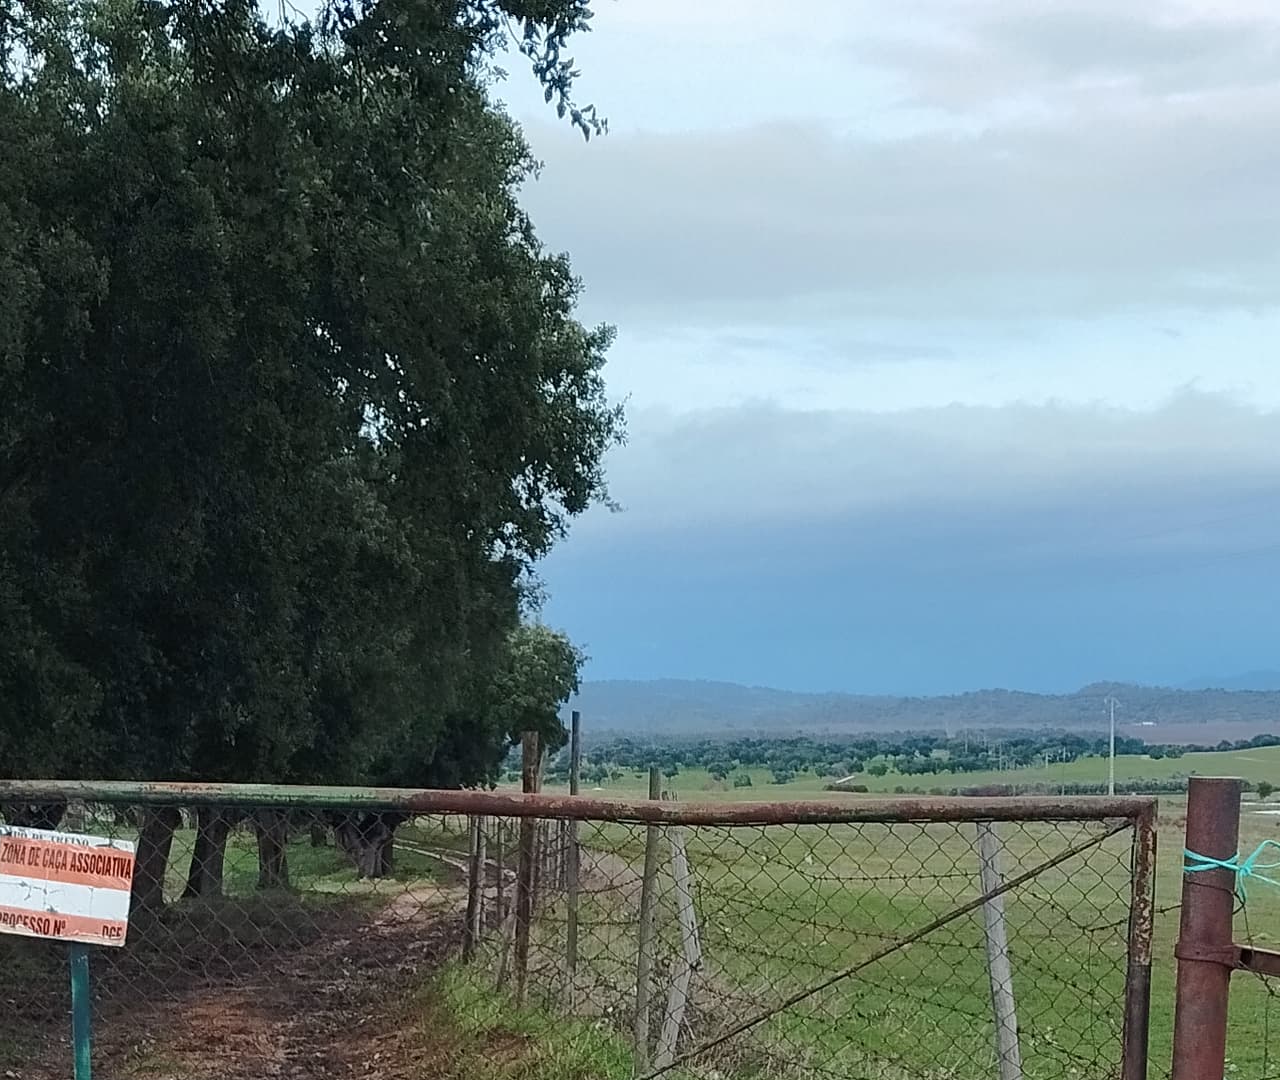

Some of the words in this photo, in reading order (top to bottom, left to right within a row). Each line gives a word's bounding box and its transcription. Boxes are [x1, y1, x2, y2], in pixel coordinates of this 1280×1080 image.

[1, 843, 26, 866] ZONA
[28, 845, 40, 867] DE
[42, 847, 67, 874] CAÇA
[69, 852, 132, 879] ASSOCIATIVA
